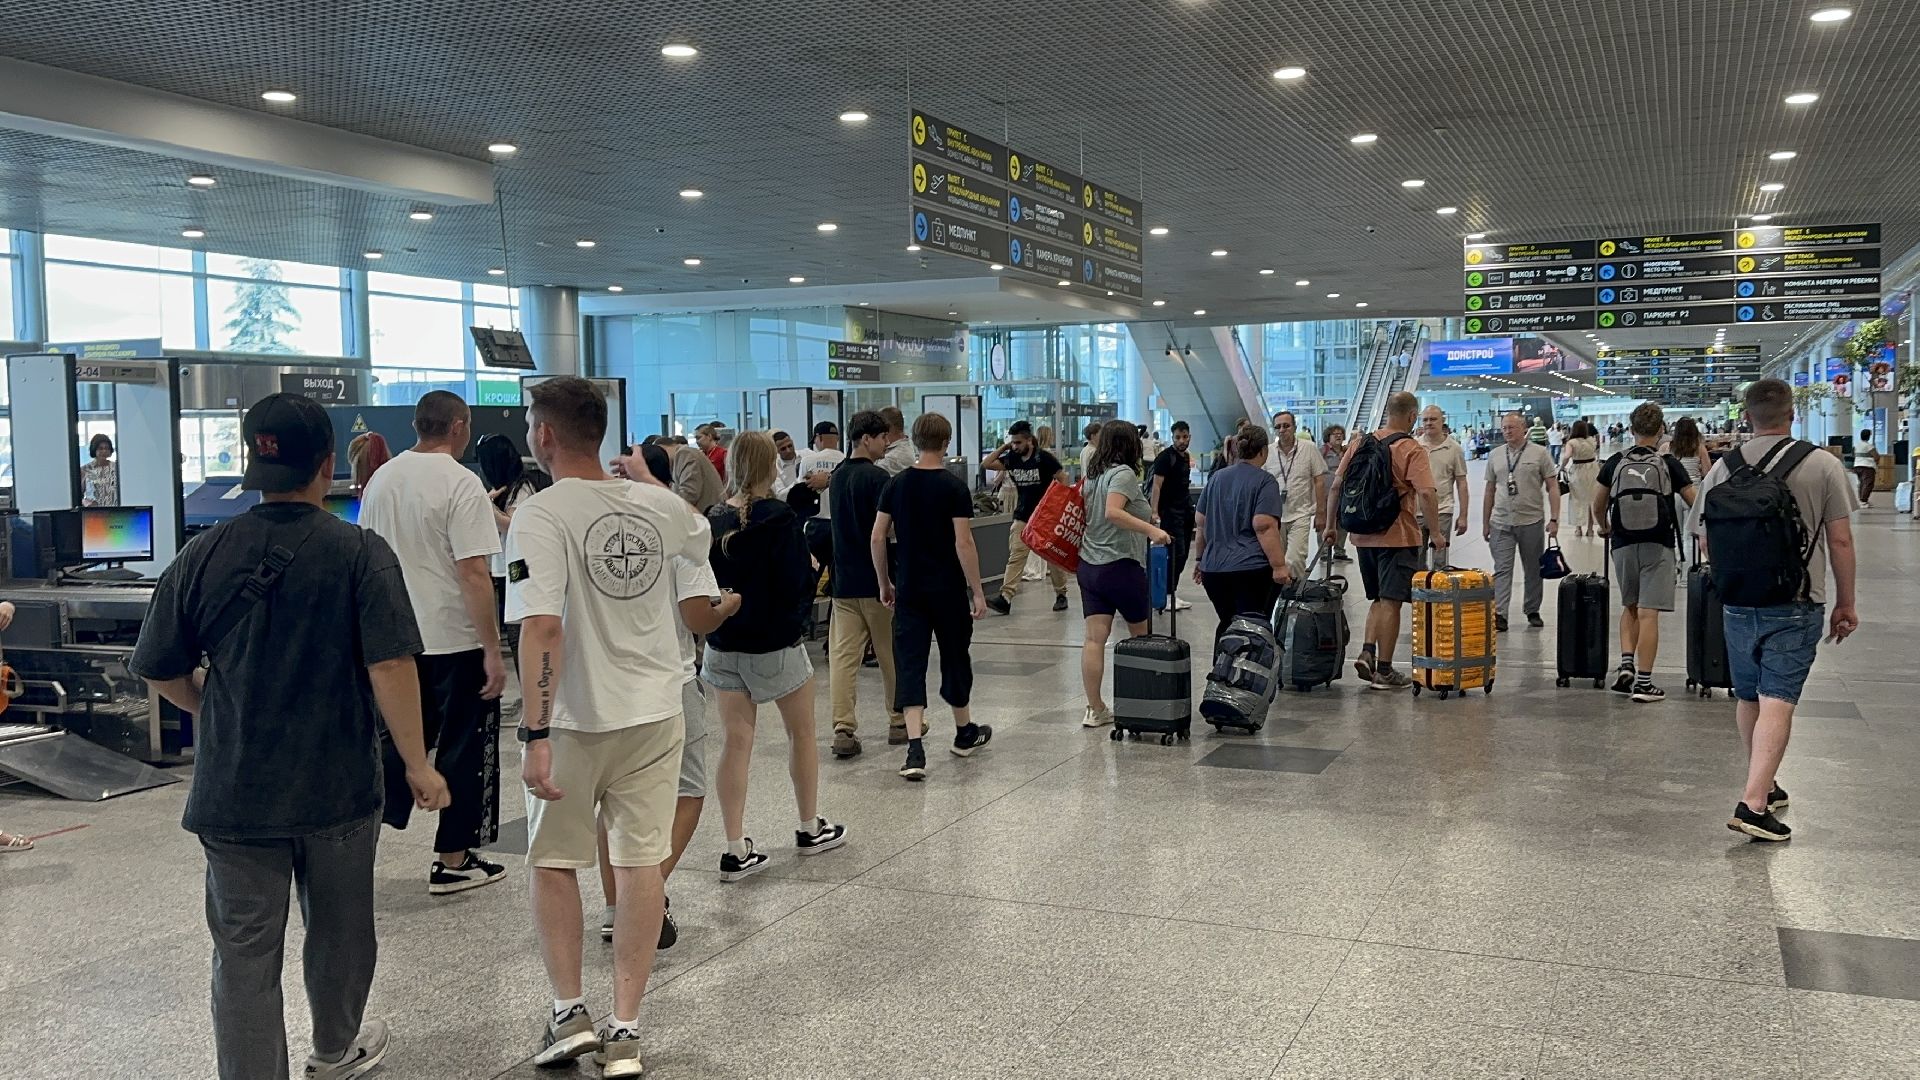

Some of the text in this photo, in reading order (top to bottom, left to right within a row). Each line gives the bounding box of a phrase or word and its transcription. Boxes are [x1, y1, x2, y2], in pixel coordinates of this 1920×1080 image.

[949, 224, 976, 241] МЕДПУНКТ
[1509, 270, 1535, 278] ВЫХОД
[1643, 286, 1683, 295] МЕДПУНКТ
[1509, 294, 1546, 302] АВТОБУСЫ
[1644, 311, 1677, 319] ПАРКИНГ
[1509, 316, 1541, 325] ПАРКИНГ
[1447, 348, 1494, 360] ДОНСТРОЙ
[304, 378, 334, 389] ВЫХОД
[337, 380, 345, 400] 2
[485, 393, 520, 403] КРОШКА
[626, 533, 648, 553] ISLAND
